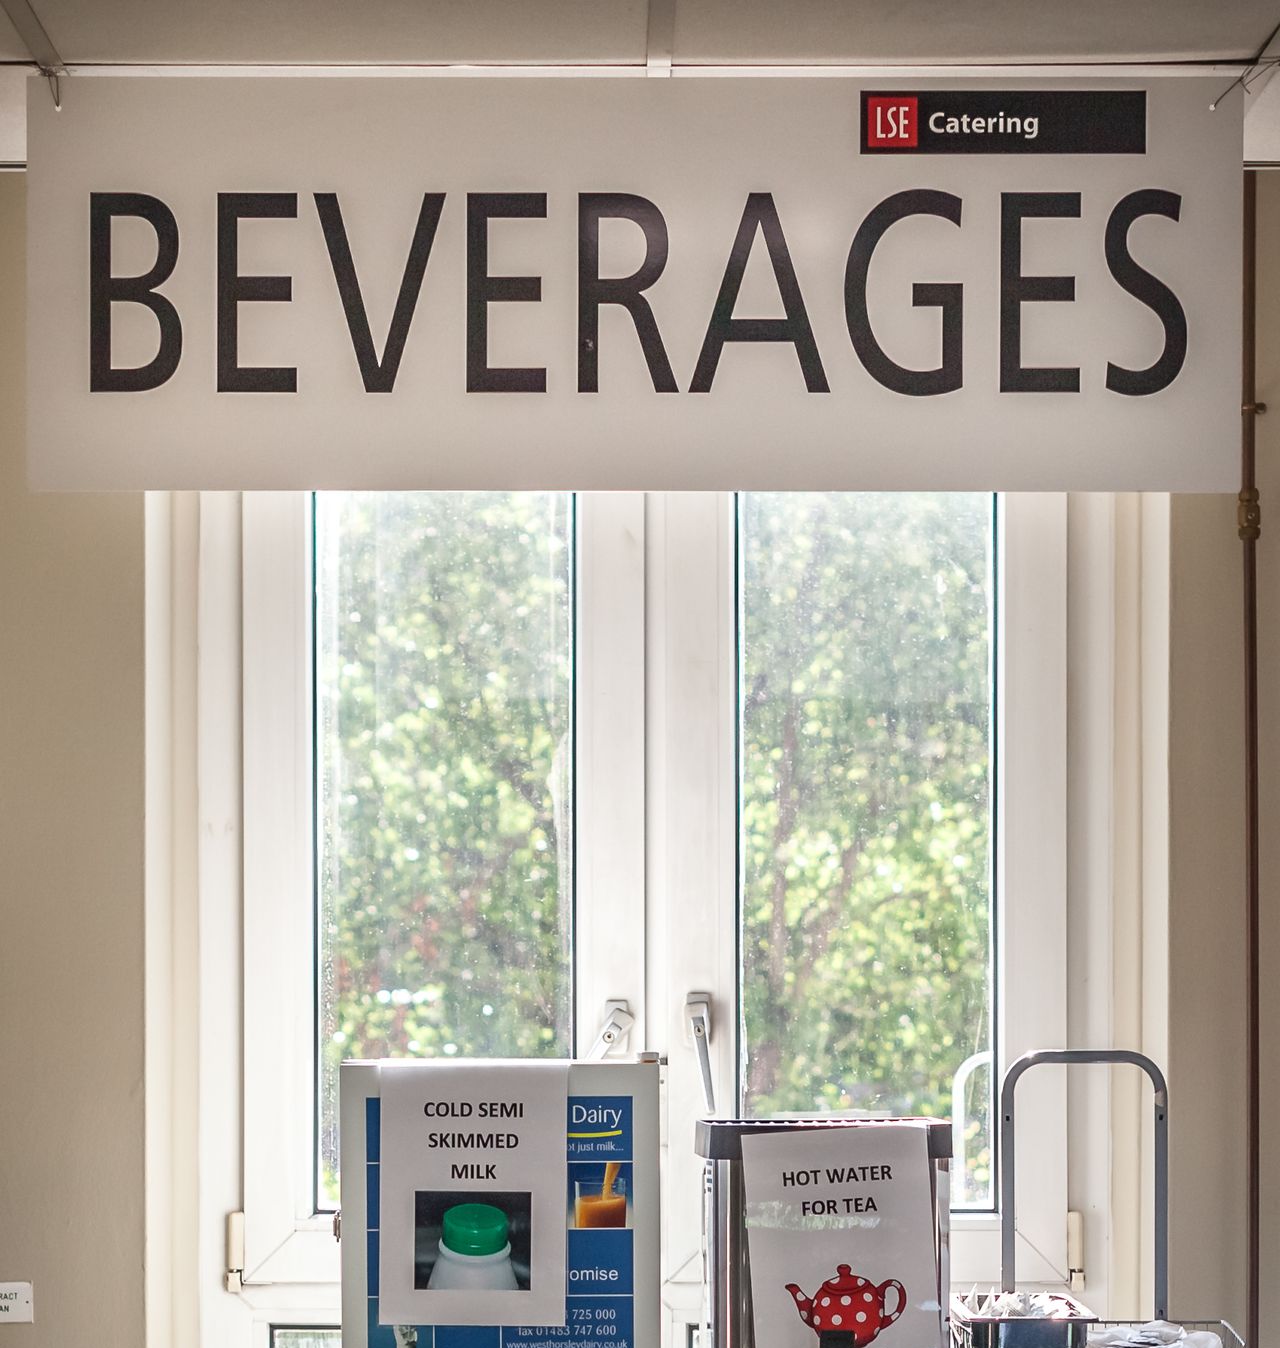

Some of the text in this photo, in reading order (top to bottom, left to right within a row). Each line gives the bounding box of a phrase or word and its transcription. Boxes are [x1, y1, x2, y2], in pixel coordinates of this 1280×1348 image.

[876, 106, 1039, 139] LSE Catering
[89, 188, 1189, 397] BEVERAGES
[423, 1101, 524, 1118] COLD SEMI
[572, 1105, 622, 1128] Dairy
[428, 1132, 519, 1149] SKIMMED
[577, 1142, 594, 1153] just
[451, 1164, 497, 1180] MILK
[782, 1165, 893, 1187] HOT WATER
[801, 1196, 878, 1217] FOR TEA
[568, 1266, 619, 1281] omise
[572, 1309, 592, 1320] 725
[595, 1309, 616, 1320] 000
[518, 1327, 533, 1336] fax
[573, 1325, 592, 1336] 747
[595, 1325, 617, 1336] 600
